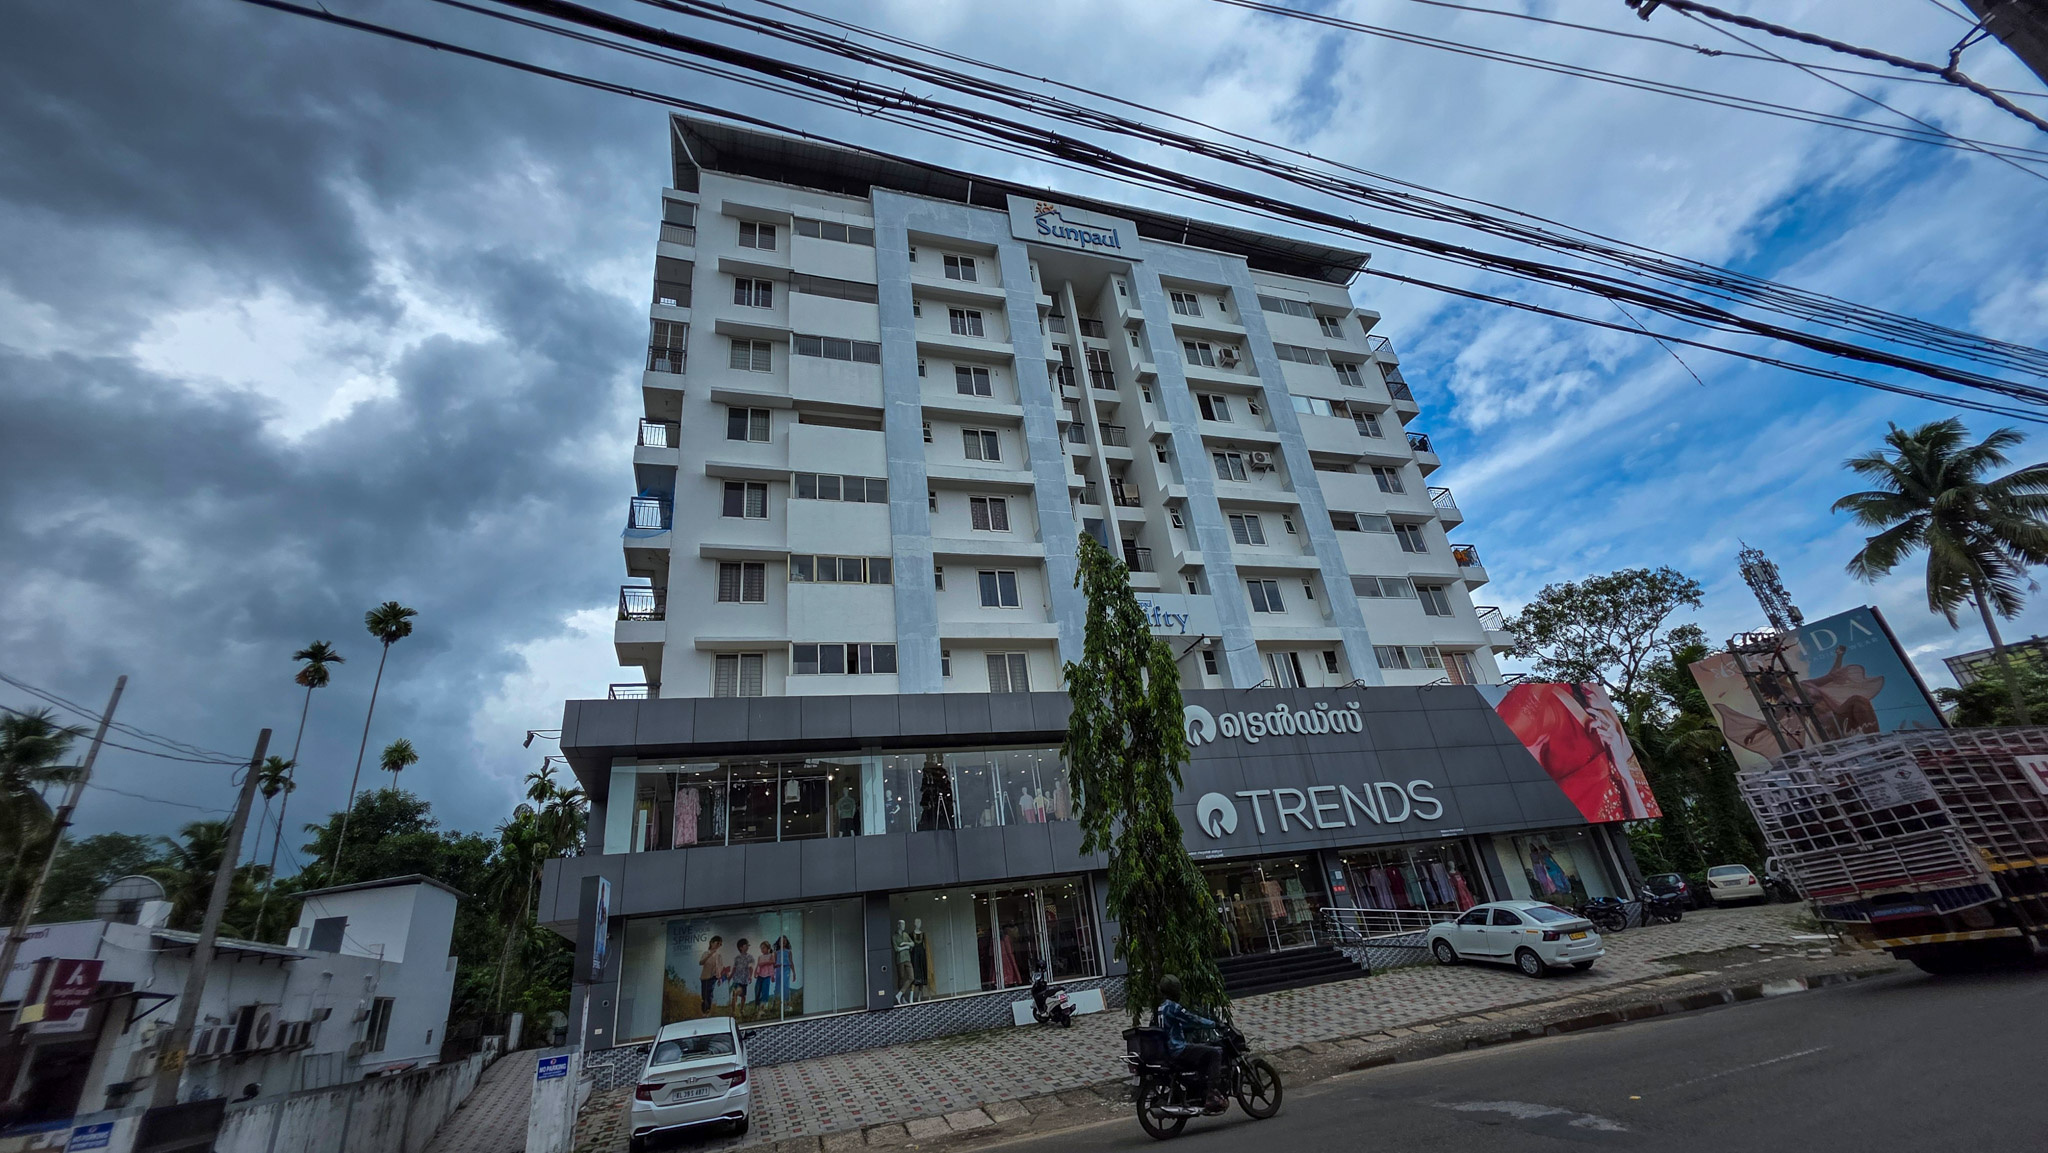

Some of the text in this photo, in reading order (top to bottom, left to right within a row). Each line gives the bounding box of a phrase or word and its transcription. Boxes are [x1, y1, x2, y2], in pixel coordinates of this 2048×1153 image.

[1036, 218, 1121, 249] Sunpaul
[1144, 606, 1189, 635] ifty
[1235, 780, 1444, 834] TRENDS
[672, 933, 708, 946] SPRING
[673, 926, 693, 935] LIVE
